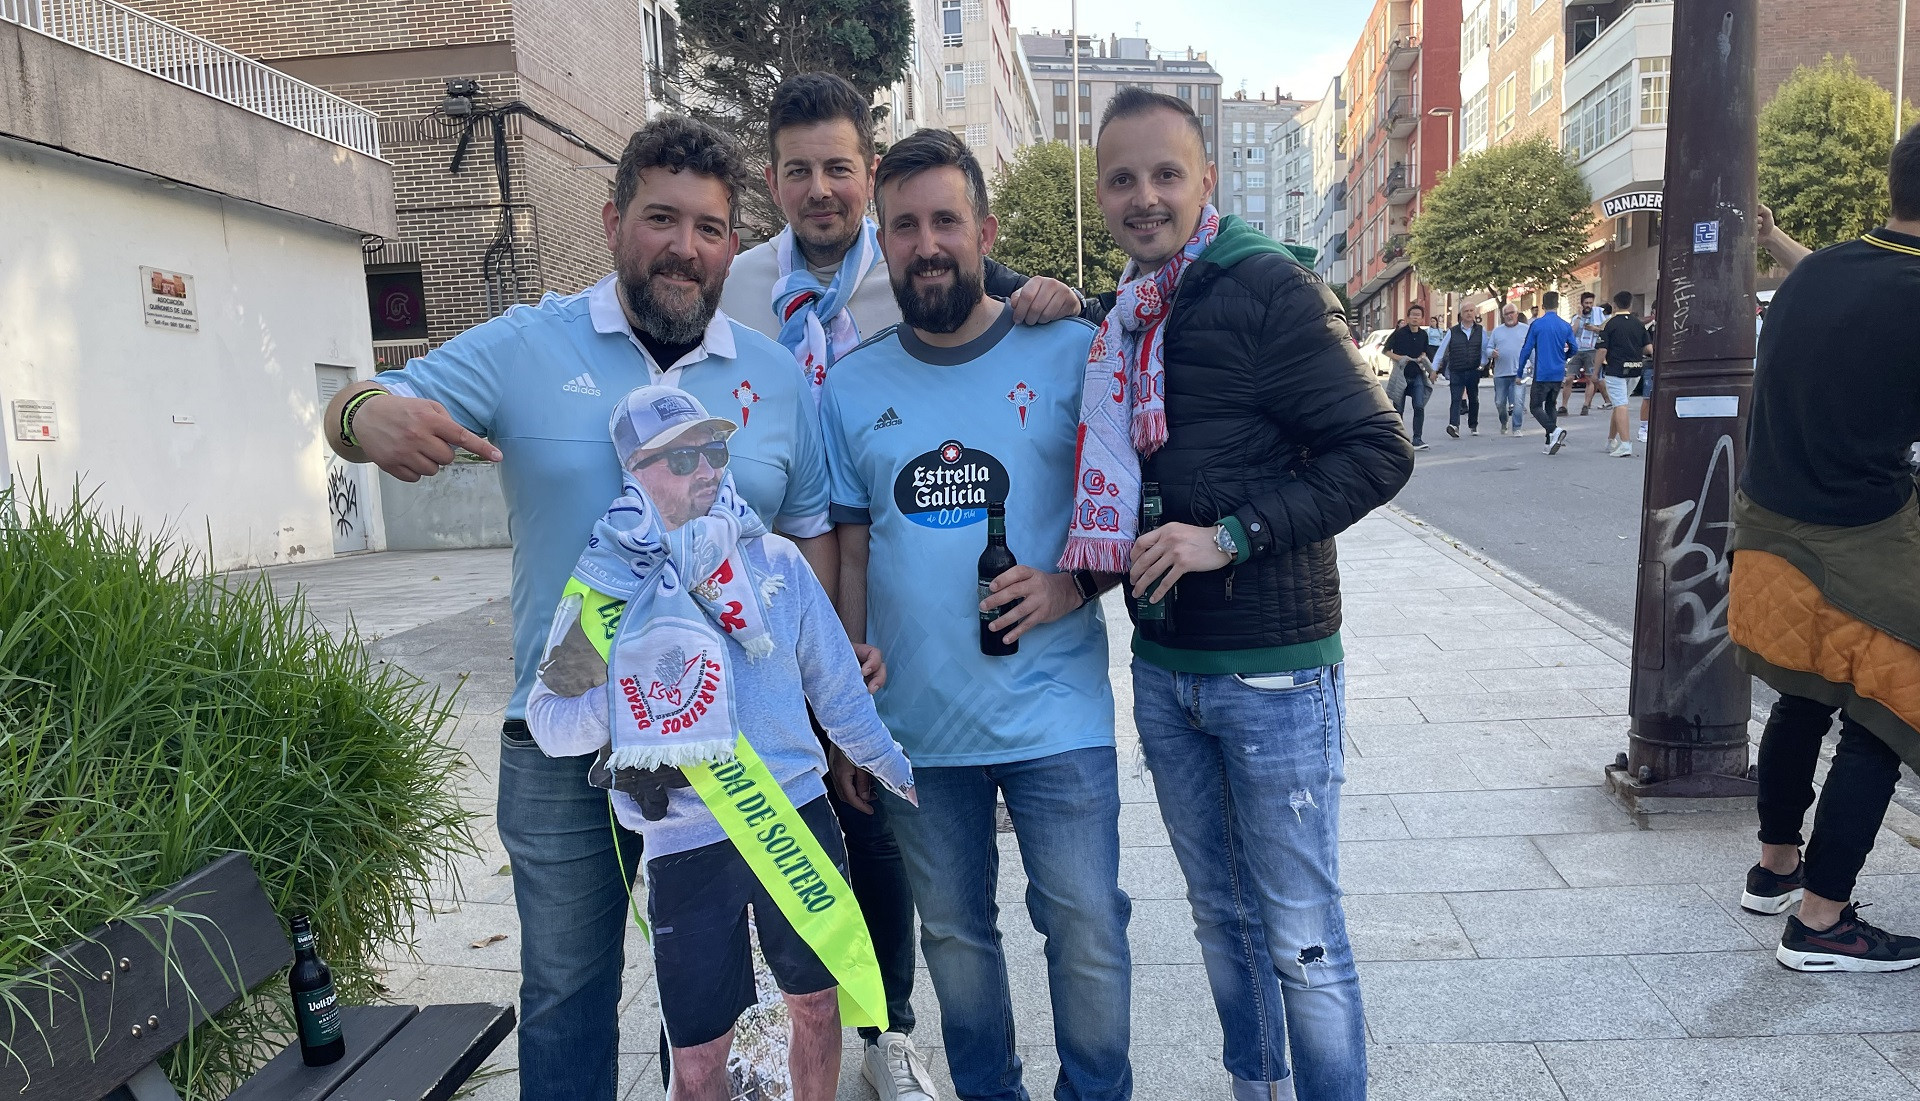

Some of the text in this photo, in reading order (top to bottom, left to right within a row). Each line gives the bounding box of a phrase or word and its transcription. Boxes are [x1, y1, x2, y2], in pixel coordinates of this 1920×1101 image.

[1606, 194, 1663, 214] PANADER
[562, 384, 602, 397] adidas
[873, 418, 903, 431] adidas
[911, 463, 991, 488] Estrella
[915, 483, 987, 508] Galicia
[619, 677, 652, 730] DEZAOS
[661, 659, 721, 735] SIAREIROS
[734, 790, 778, 829] DE
[757, 822, 837, 914] SOLTERO
